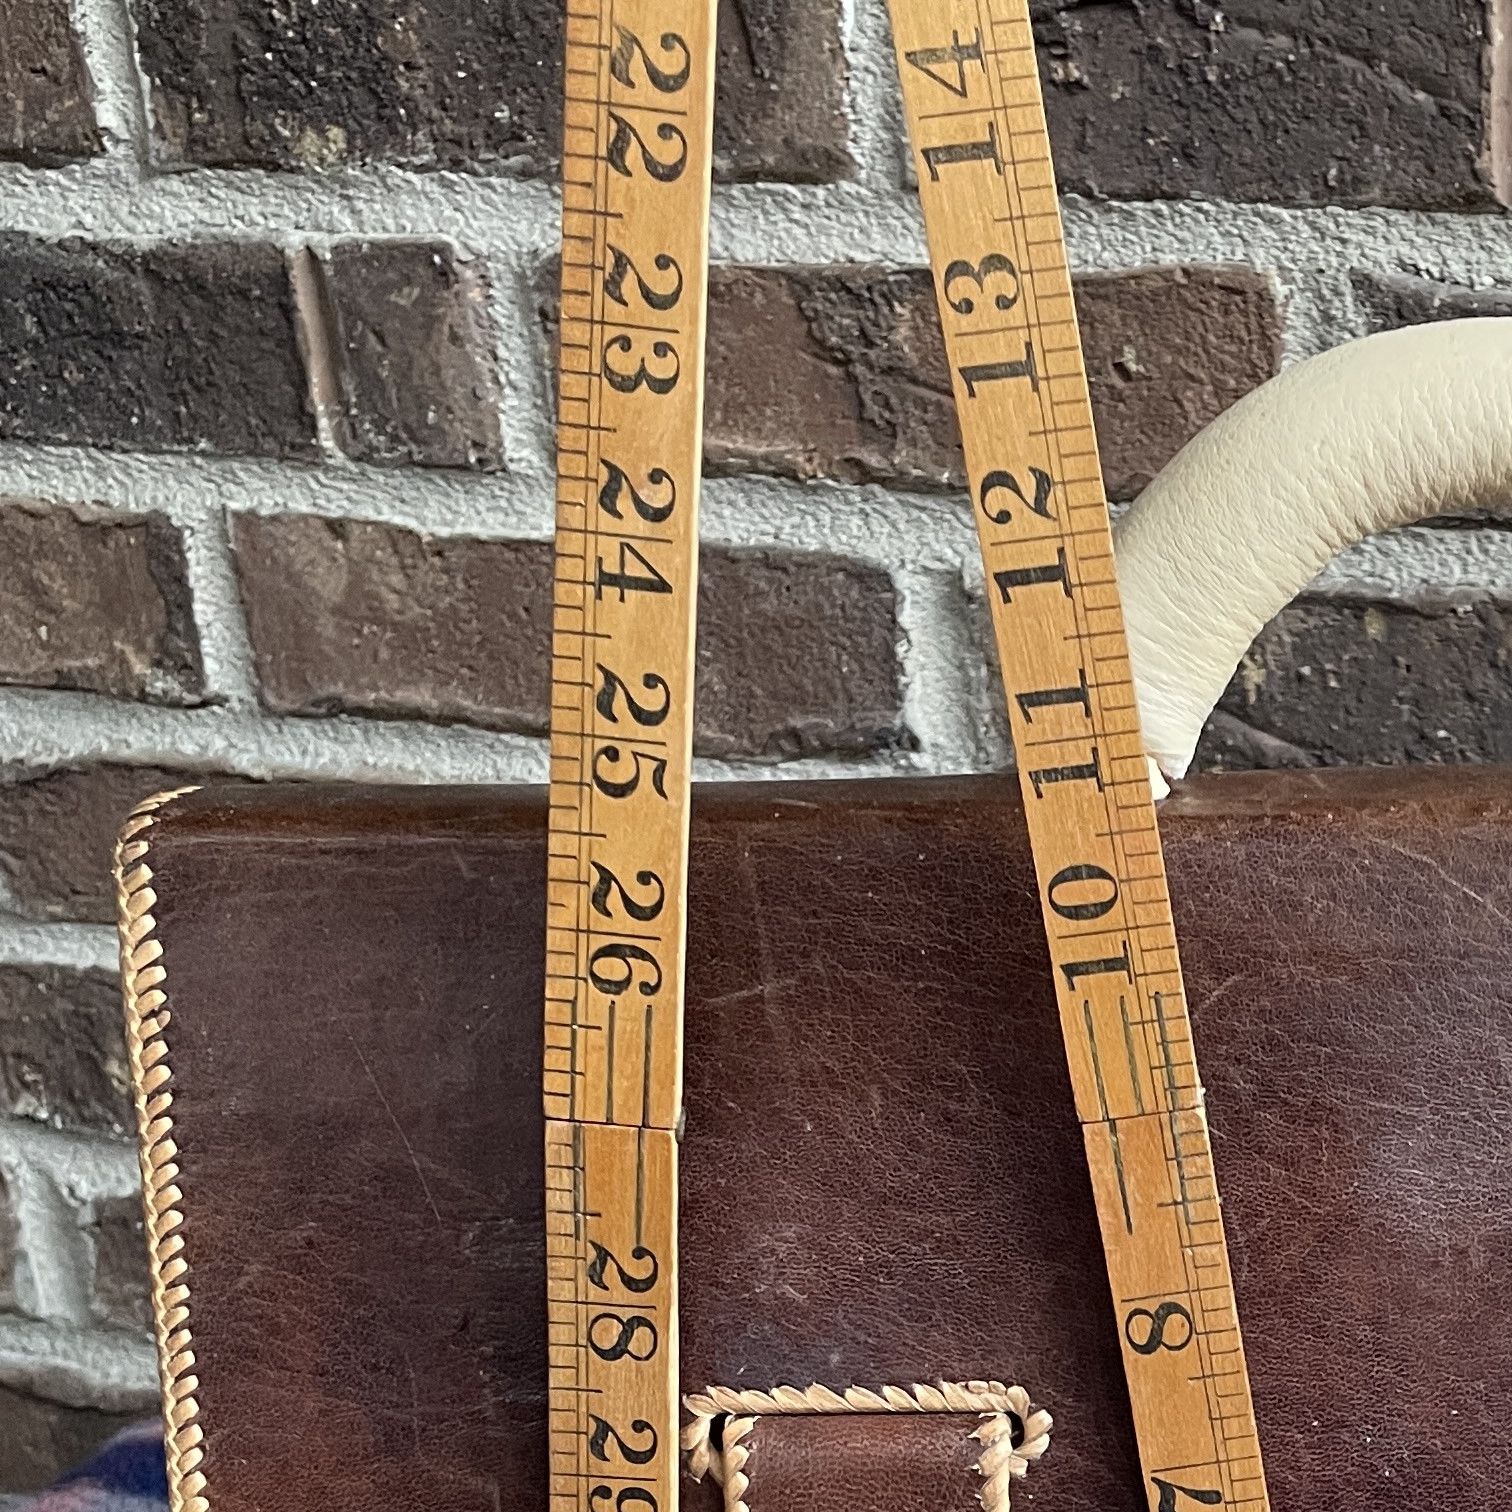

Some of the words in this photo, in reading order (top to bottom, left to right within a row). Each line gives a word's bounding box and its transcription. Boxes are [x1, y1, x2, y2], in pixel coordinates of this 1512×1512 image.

[606, 23, 691, 182] 22
[905, 26, 1004, 182] 14
[603, 243, 683, 394] 23
[943, 252, 1041, 399] 13
[594, 458, 675, 603] 24
[980, 465, 1074, 605] 12
[591, 663, 672, 800] 25
[1013, 667, 1107, 800] 11
[588, 861, 666, 996] 26
[1048, 863, 1135, 993] 10
[586, 1243, 658, 1362] 28
[1125, 1301, 1193, 1355] 8
